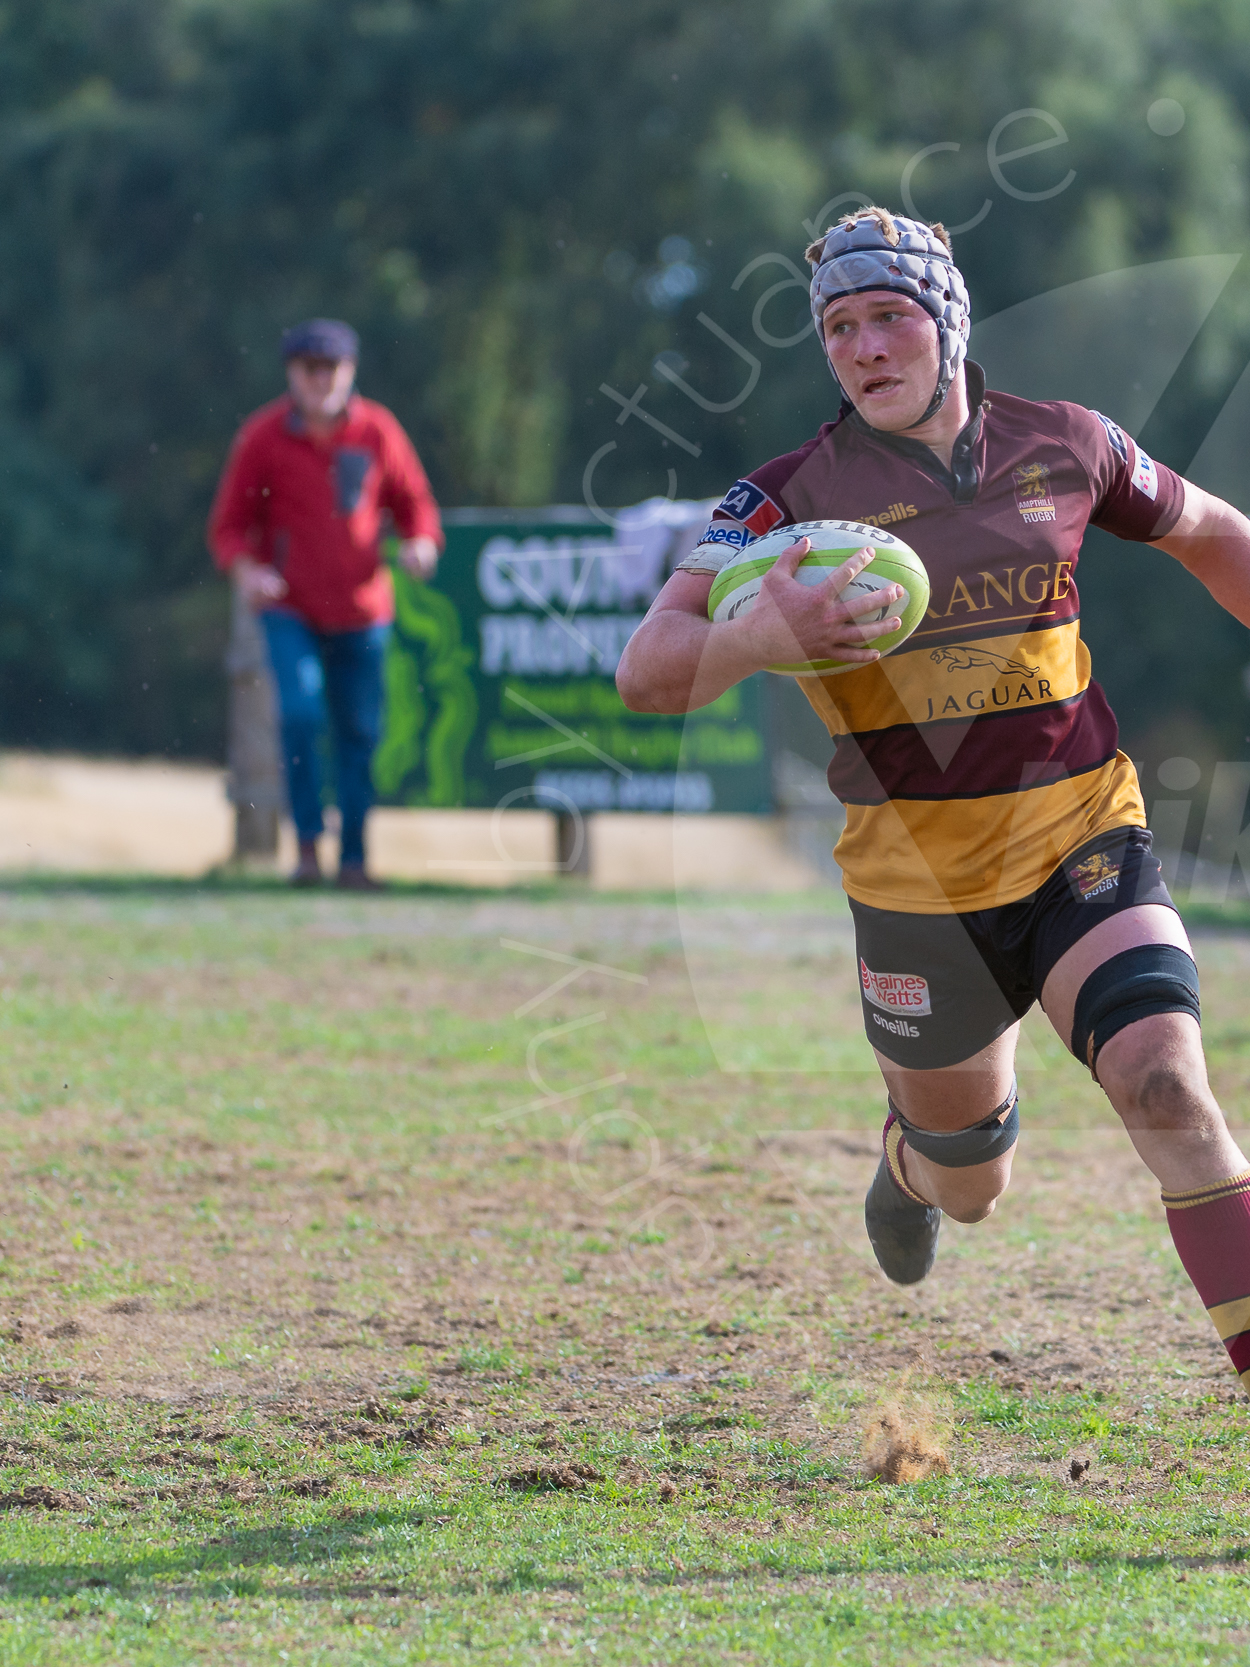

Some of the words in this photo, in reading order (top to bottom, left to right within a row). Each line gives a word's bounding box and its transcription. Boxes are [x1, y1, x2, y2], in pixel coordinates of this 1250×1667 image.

[1018, 498, 1052, 510] AMPTHILL
[1022, 510, 1057, 523] RUGBY
[926, 679, 1053, 720] JAGUAR
[869, 972, 926, 990] Haines
[871, 984, 923, 1006] Watts
